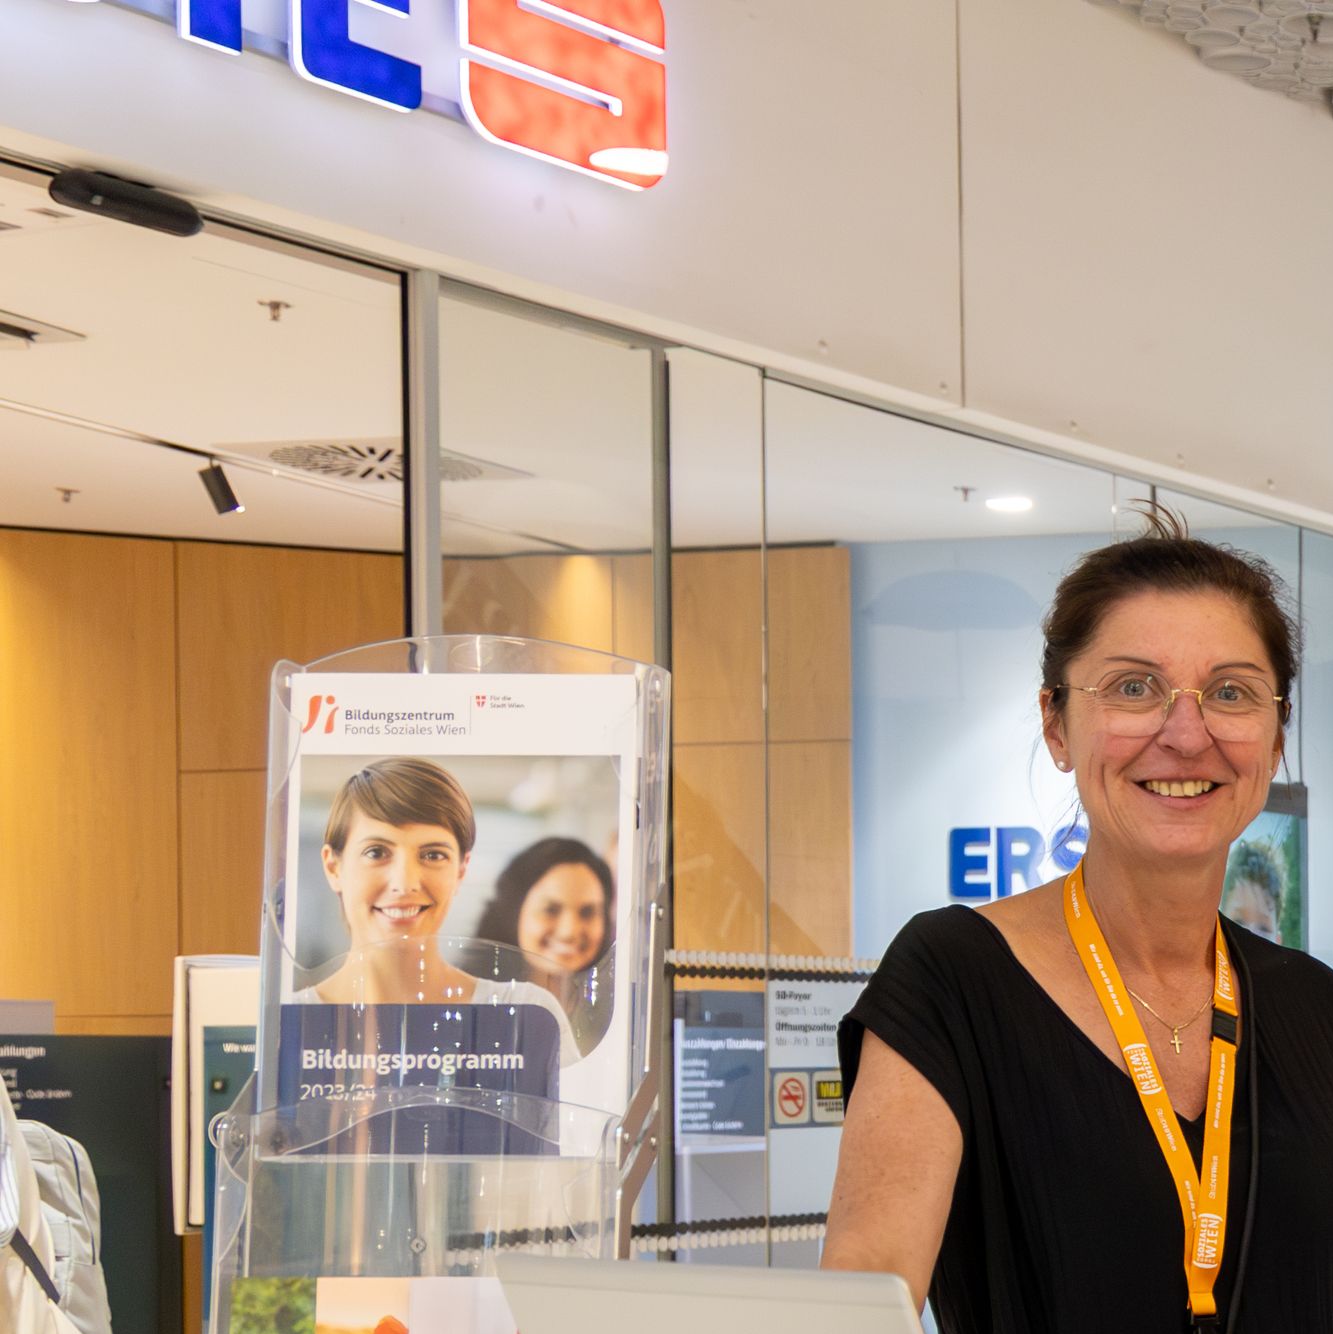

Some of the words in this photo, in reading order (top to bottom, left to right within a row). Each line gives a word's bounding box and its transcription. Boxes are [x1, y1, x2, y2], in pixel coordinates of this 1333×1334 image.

[344, 709, 455, 723] Bildungszentrum
[344, 724, 380, 735] Fonds
[384, 724, 433, 735] Soziales
[436, 724, 466, 735] Wien
[302, 1049, 524, 1075] Bildungsprogramm
[1128, 1055, 1150, 1091] WIEN
[1140, 1052, 1160, 1089] SOZIALES
[1197, 1218, 1208, 1257] SOZIALES
[1206, 1219, 1220, 1259] WIEN
